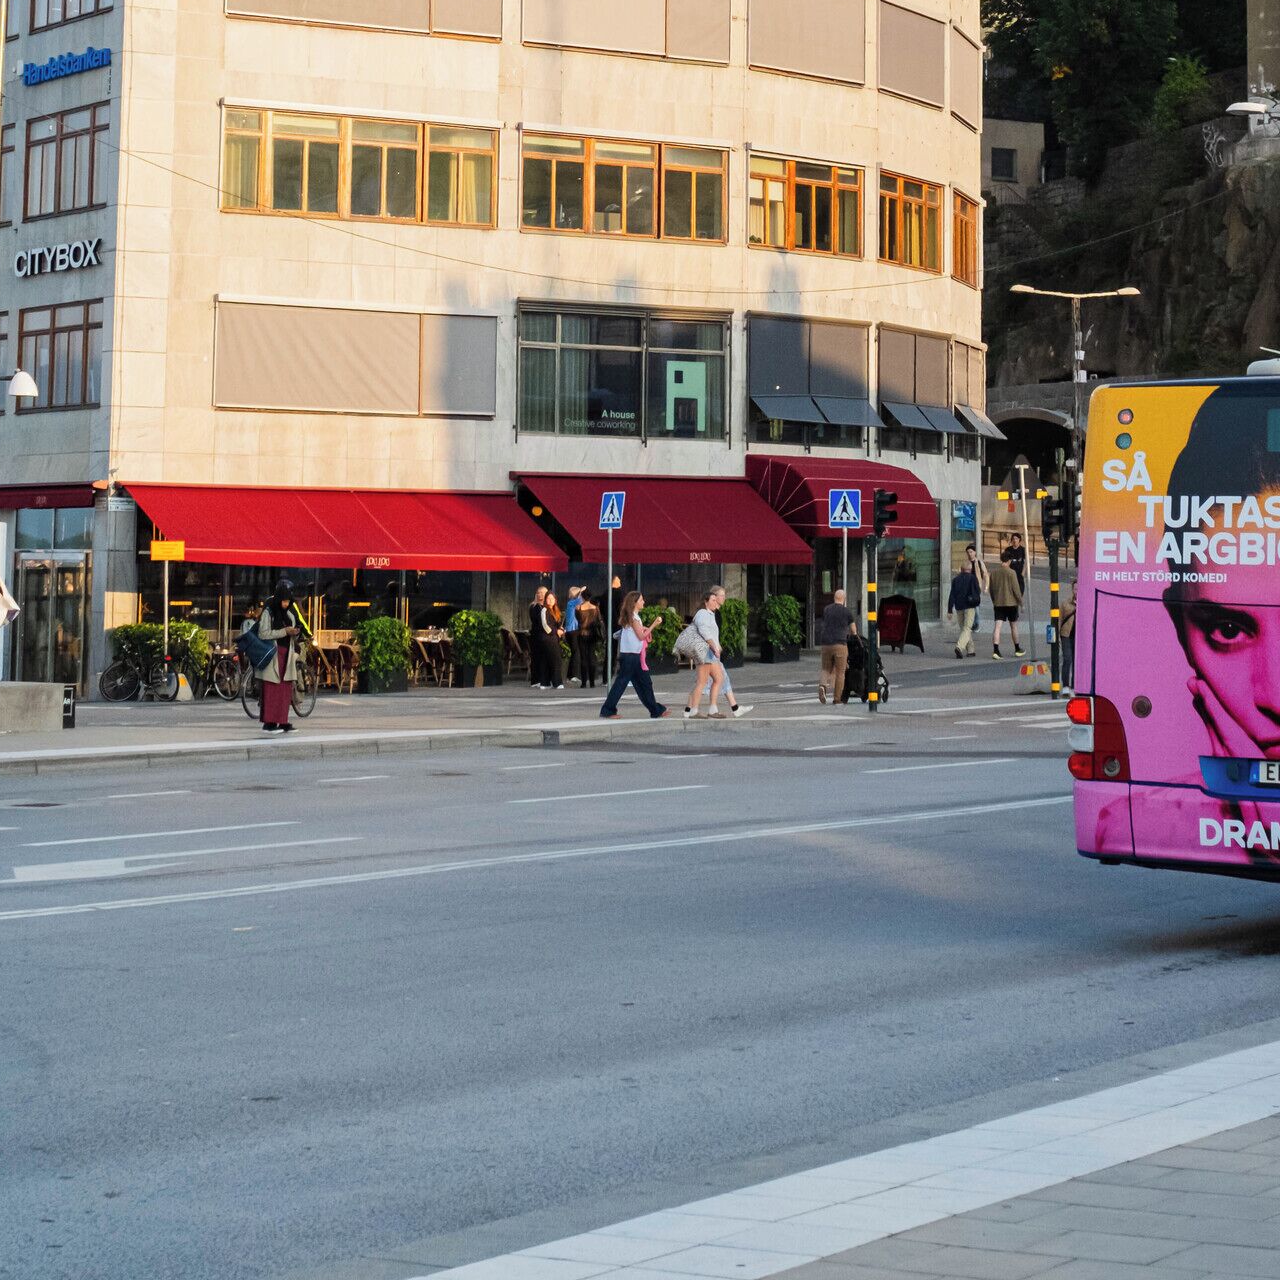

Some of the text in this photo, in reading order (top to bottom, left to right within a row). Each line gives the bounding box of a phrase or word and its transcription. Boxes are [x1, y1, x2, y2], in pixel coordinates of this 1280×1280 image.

[23, 46, 111, 87] Handelsbanken
[14, 238, 103, 277] CITYBOX
[564, 418, 636, 431] Creative coworking
[602, 409, 635, 419] A house
[1102, 451, 1153, 492] SÅ
[1095, 531, 1146, 564] EN
[365, 556, 390, 567] LOU LOU
[1095, 568, 1228, 584] EN HELT STÖRD KOMEDI
